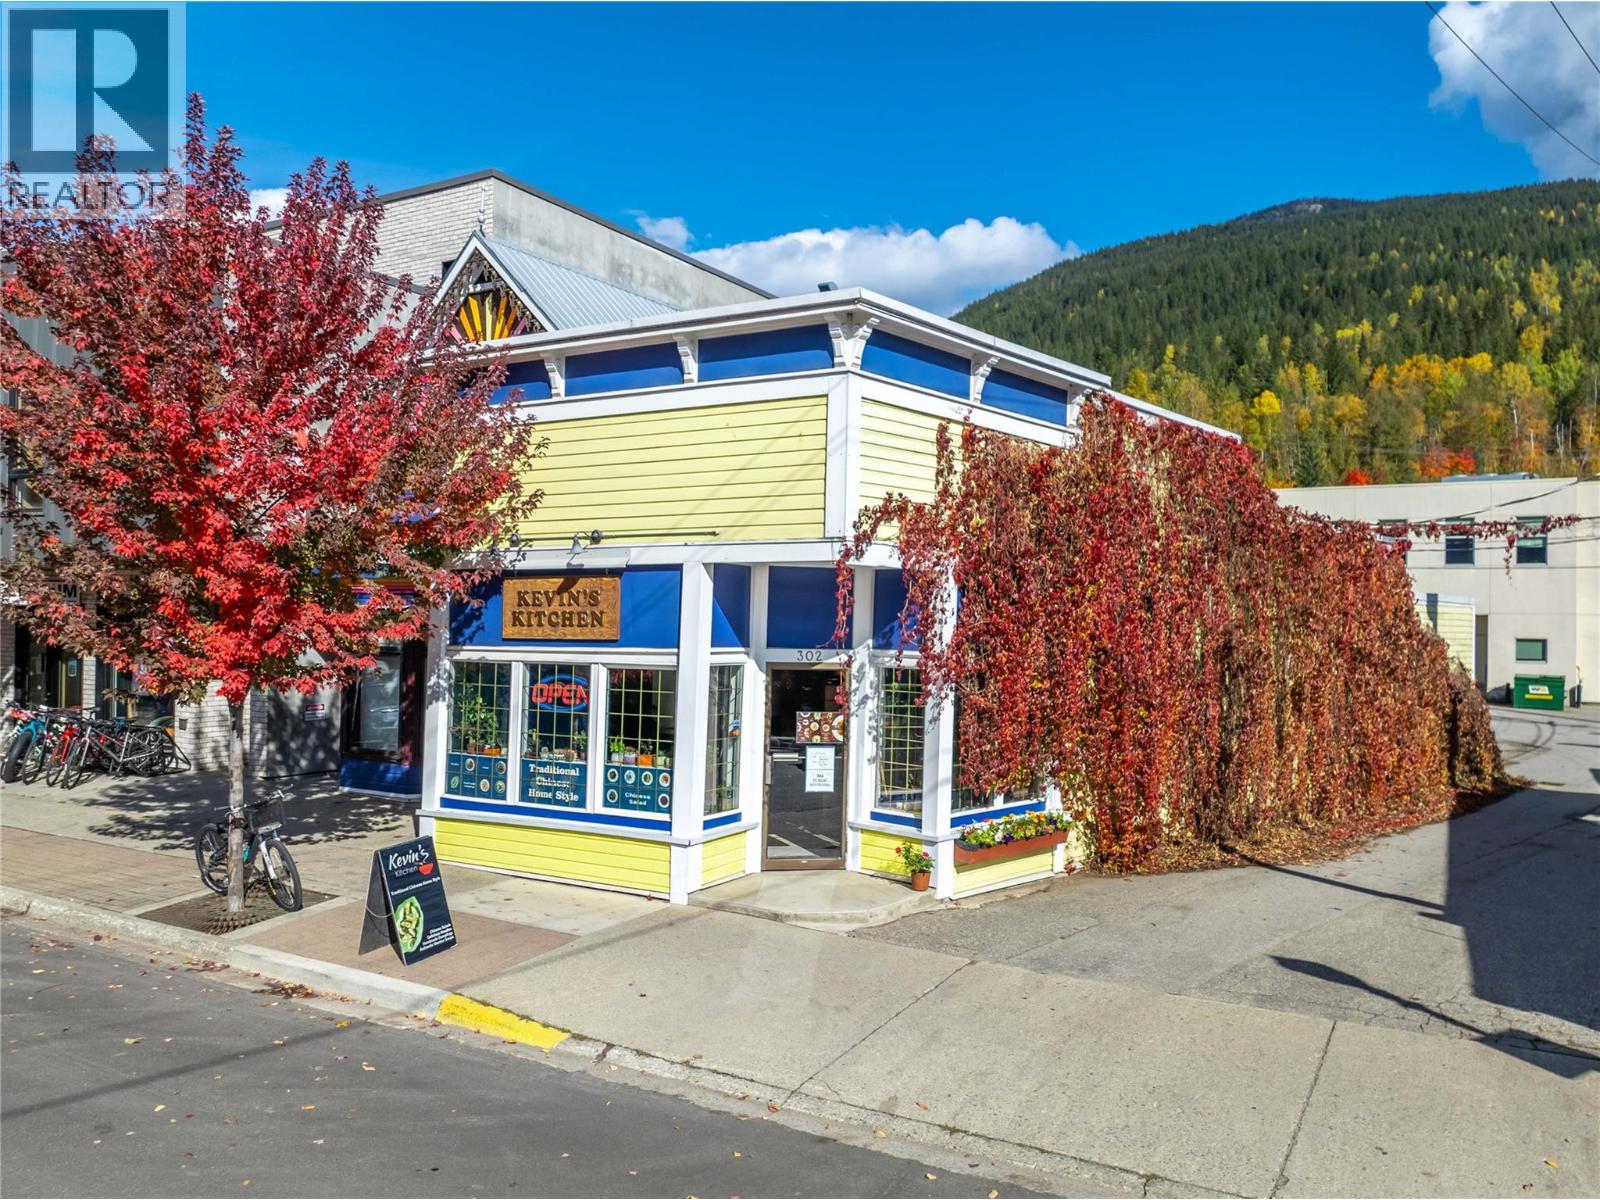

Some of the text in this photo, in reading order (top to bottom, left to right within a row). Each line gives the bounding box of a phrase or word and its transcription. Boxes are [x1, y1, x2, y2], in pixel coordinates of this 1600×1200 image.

[516, 589, 601, 607] KEVIN'S
[511, 610, 605, 627] KITCHEN
[796, 650, 823, 662] 302
[532, 683, 588, 705] OPEN
[528, 763, 580, 777] Traditional
[528, 788, 579, 803] Home Style
[389, 844, 430, 871] Kevin's
